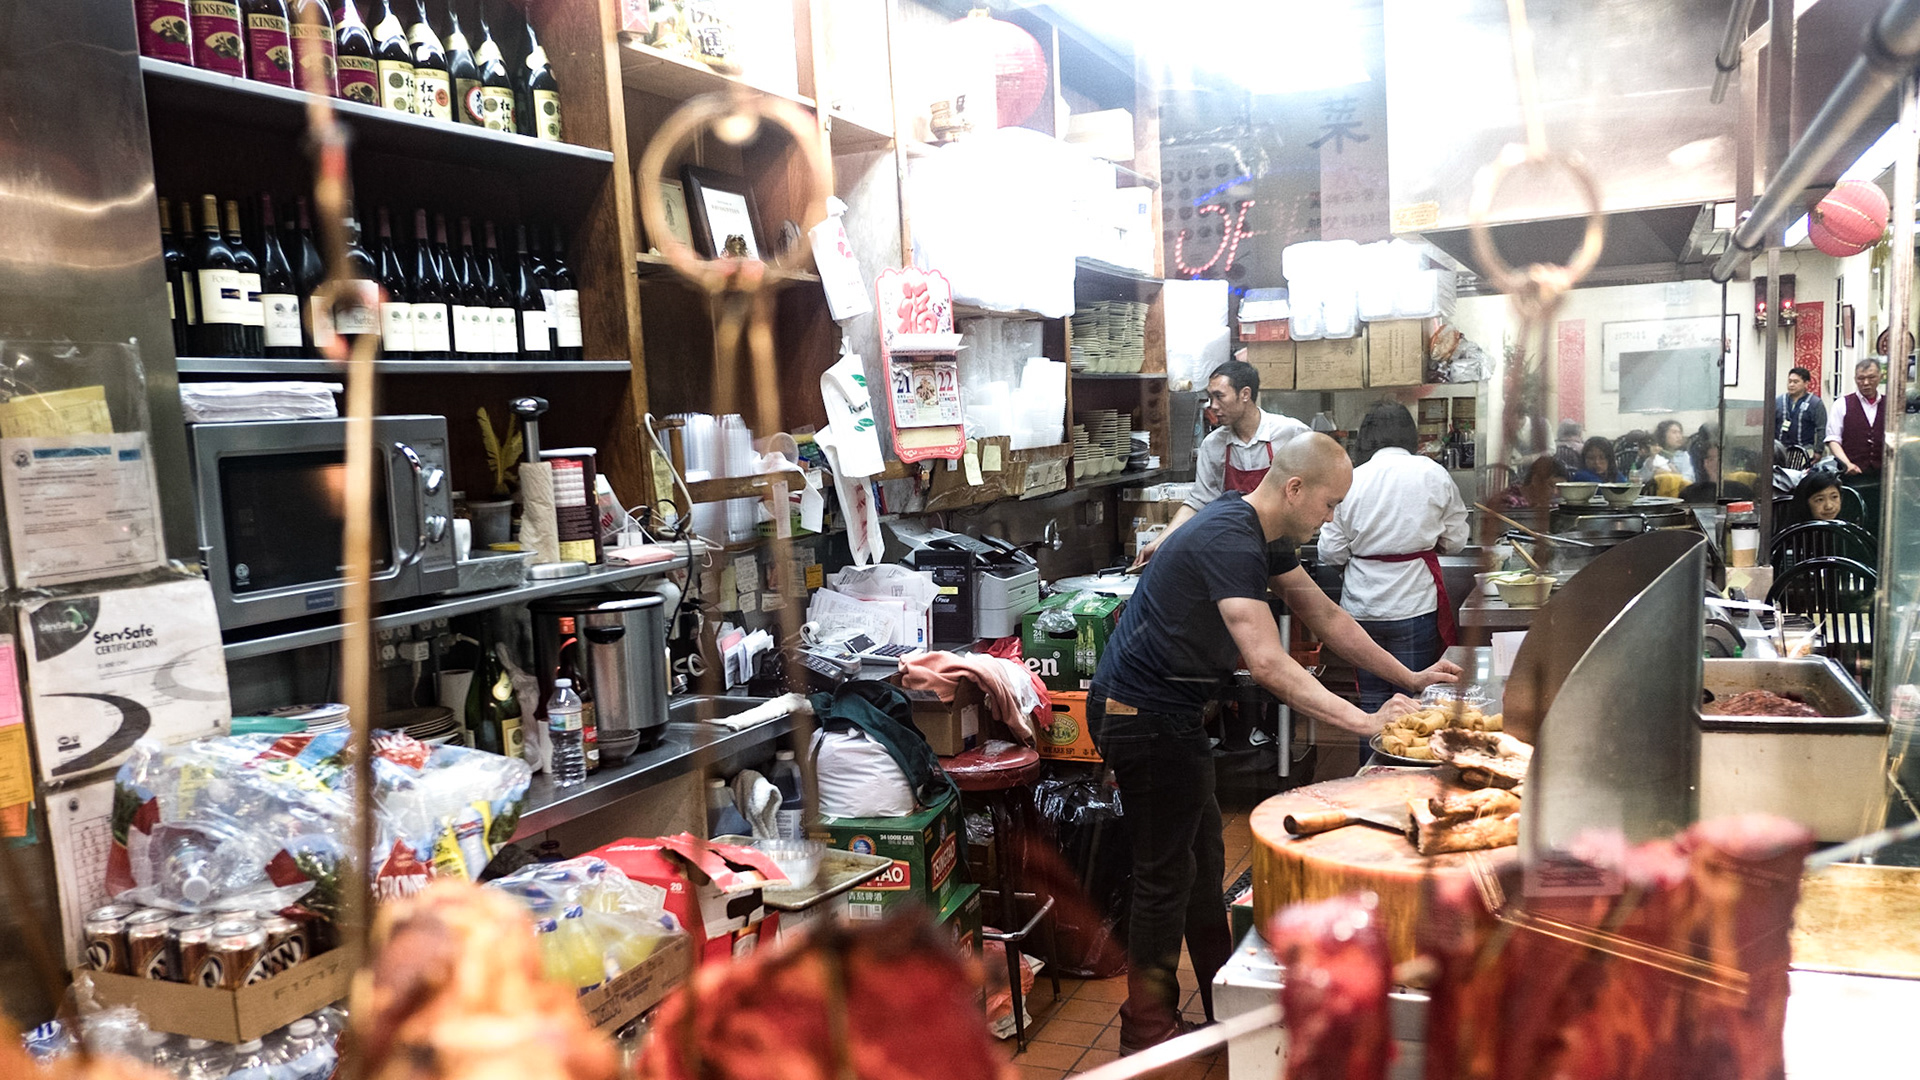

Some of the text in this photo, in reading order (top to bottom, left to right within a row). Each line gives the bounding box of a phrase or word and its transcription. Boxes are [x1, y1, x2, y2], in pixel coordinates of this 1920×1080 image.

[897, 282, 938, 334] 福
[937, 371, 954, 392] 22
[94, 624, 154, 645] ServSafe
[1033, 629, 1042, 637] 24
[95, 638, 158, 656] CERTIFICATION
[875, 867, 904, 883] AO
[670, 882, 683, 891] 20
